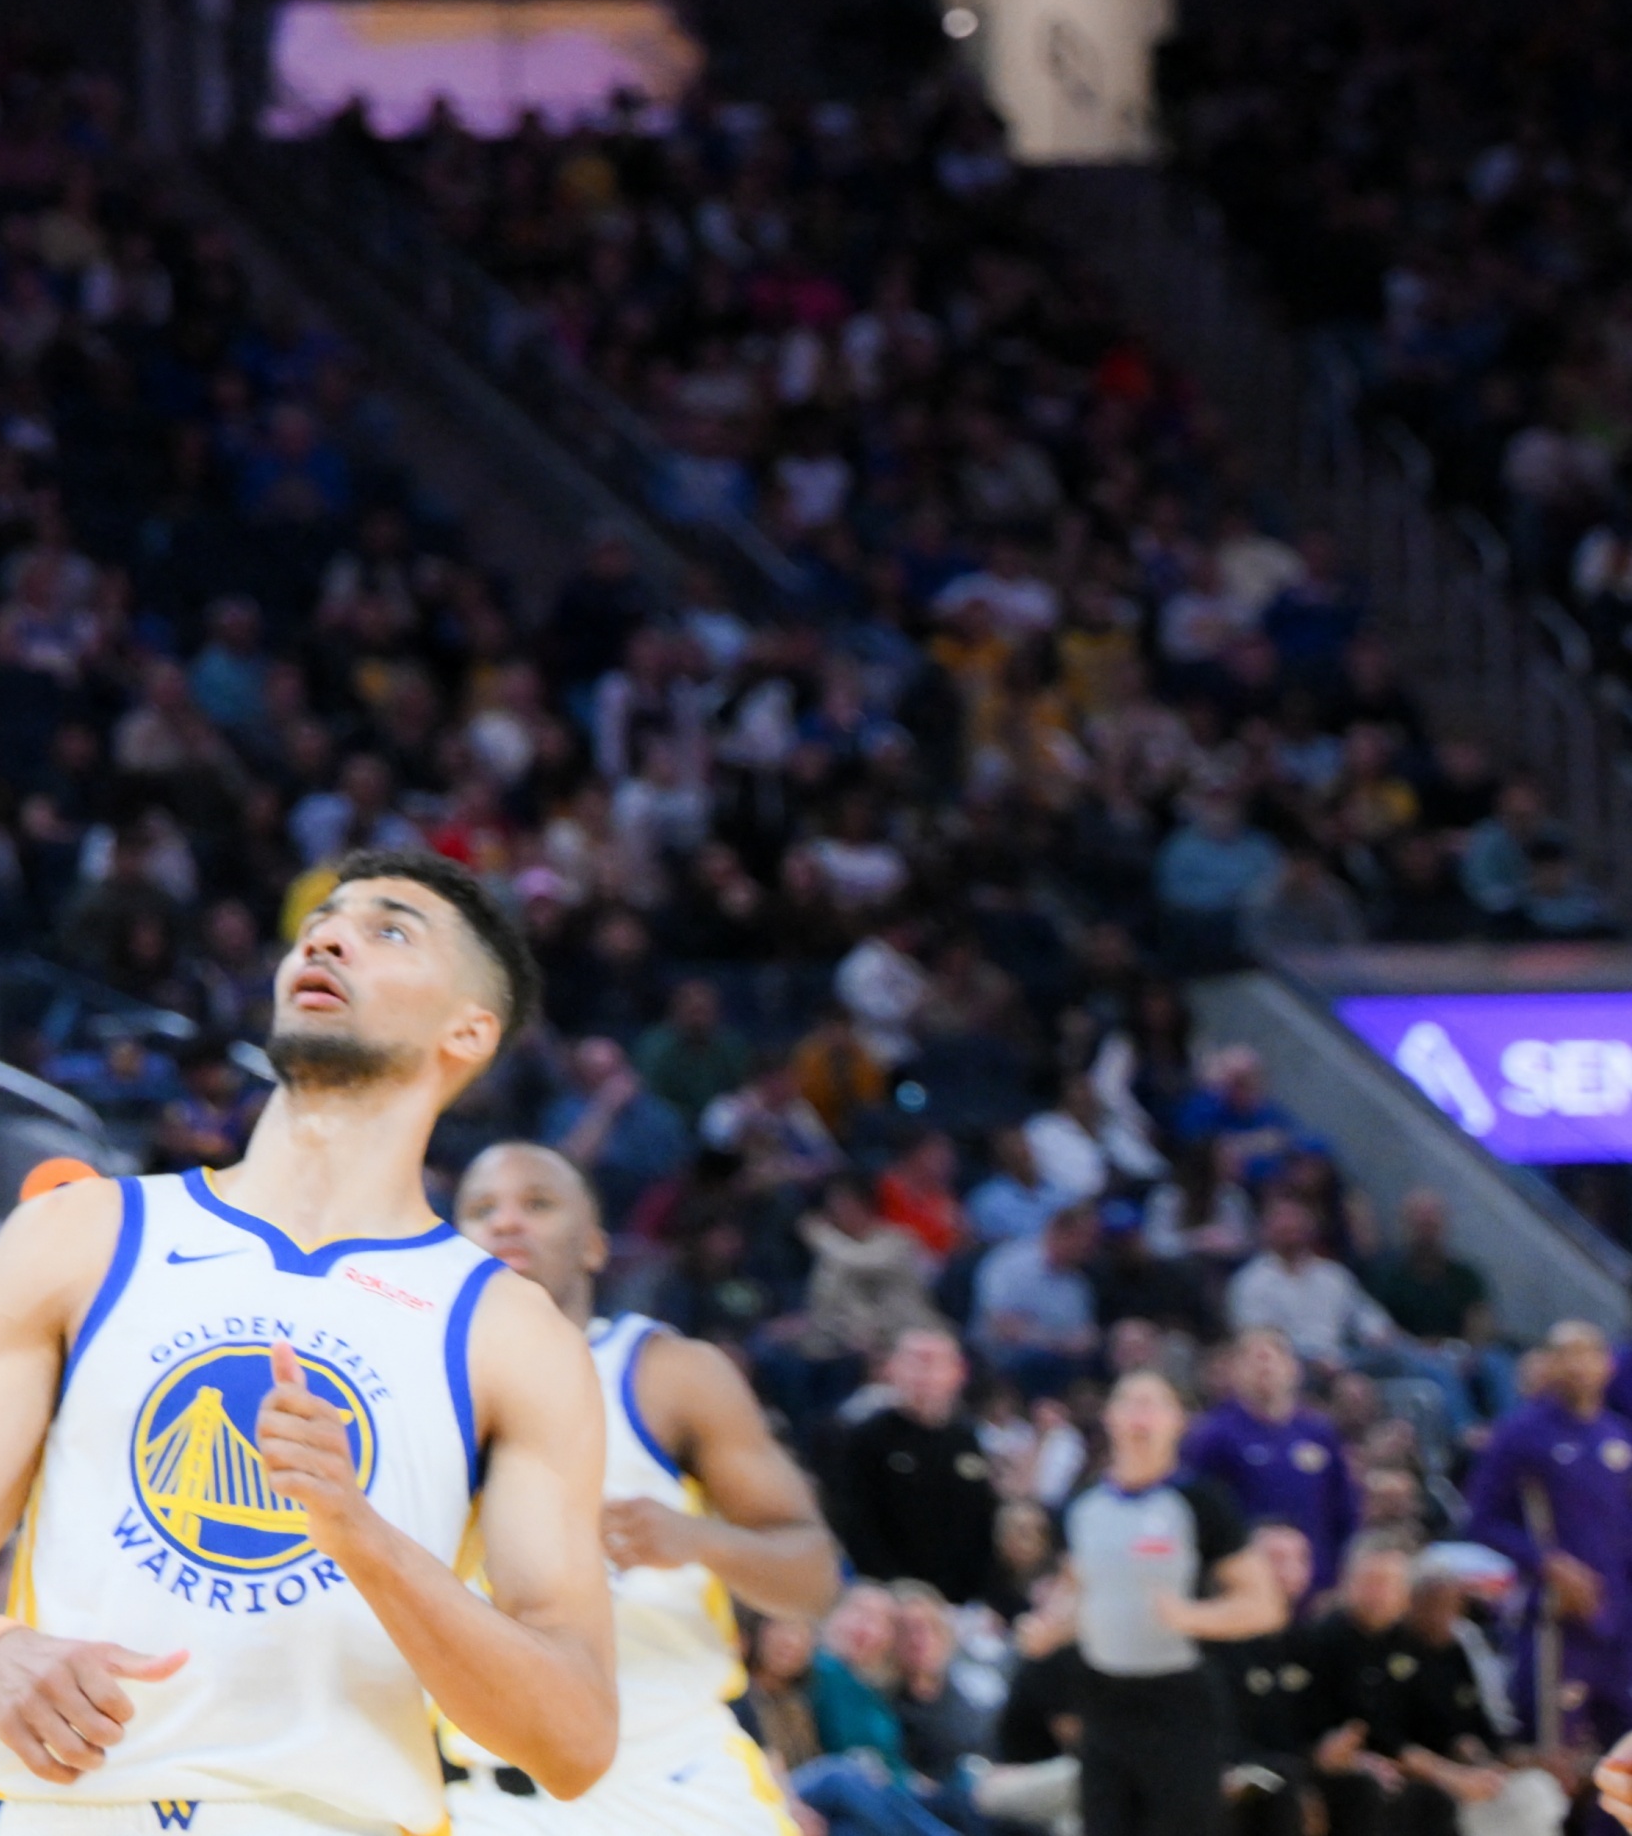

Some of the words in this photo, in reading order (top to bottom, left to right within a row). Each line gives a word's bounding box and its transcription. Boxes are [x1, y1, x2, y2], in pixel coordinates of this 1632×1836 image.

[148, 1315, 296, 1365] GOLDEN
[308, 1328, 392, 1404] STATE
[112, 1505, 347, 1615] WARRIOR
